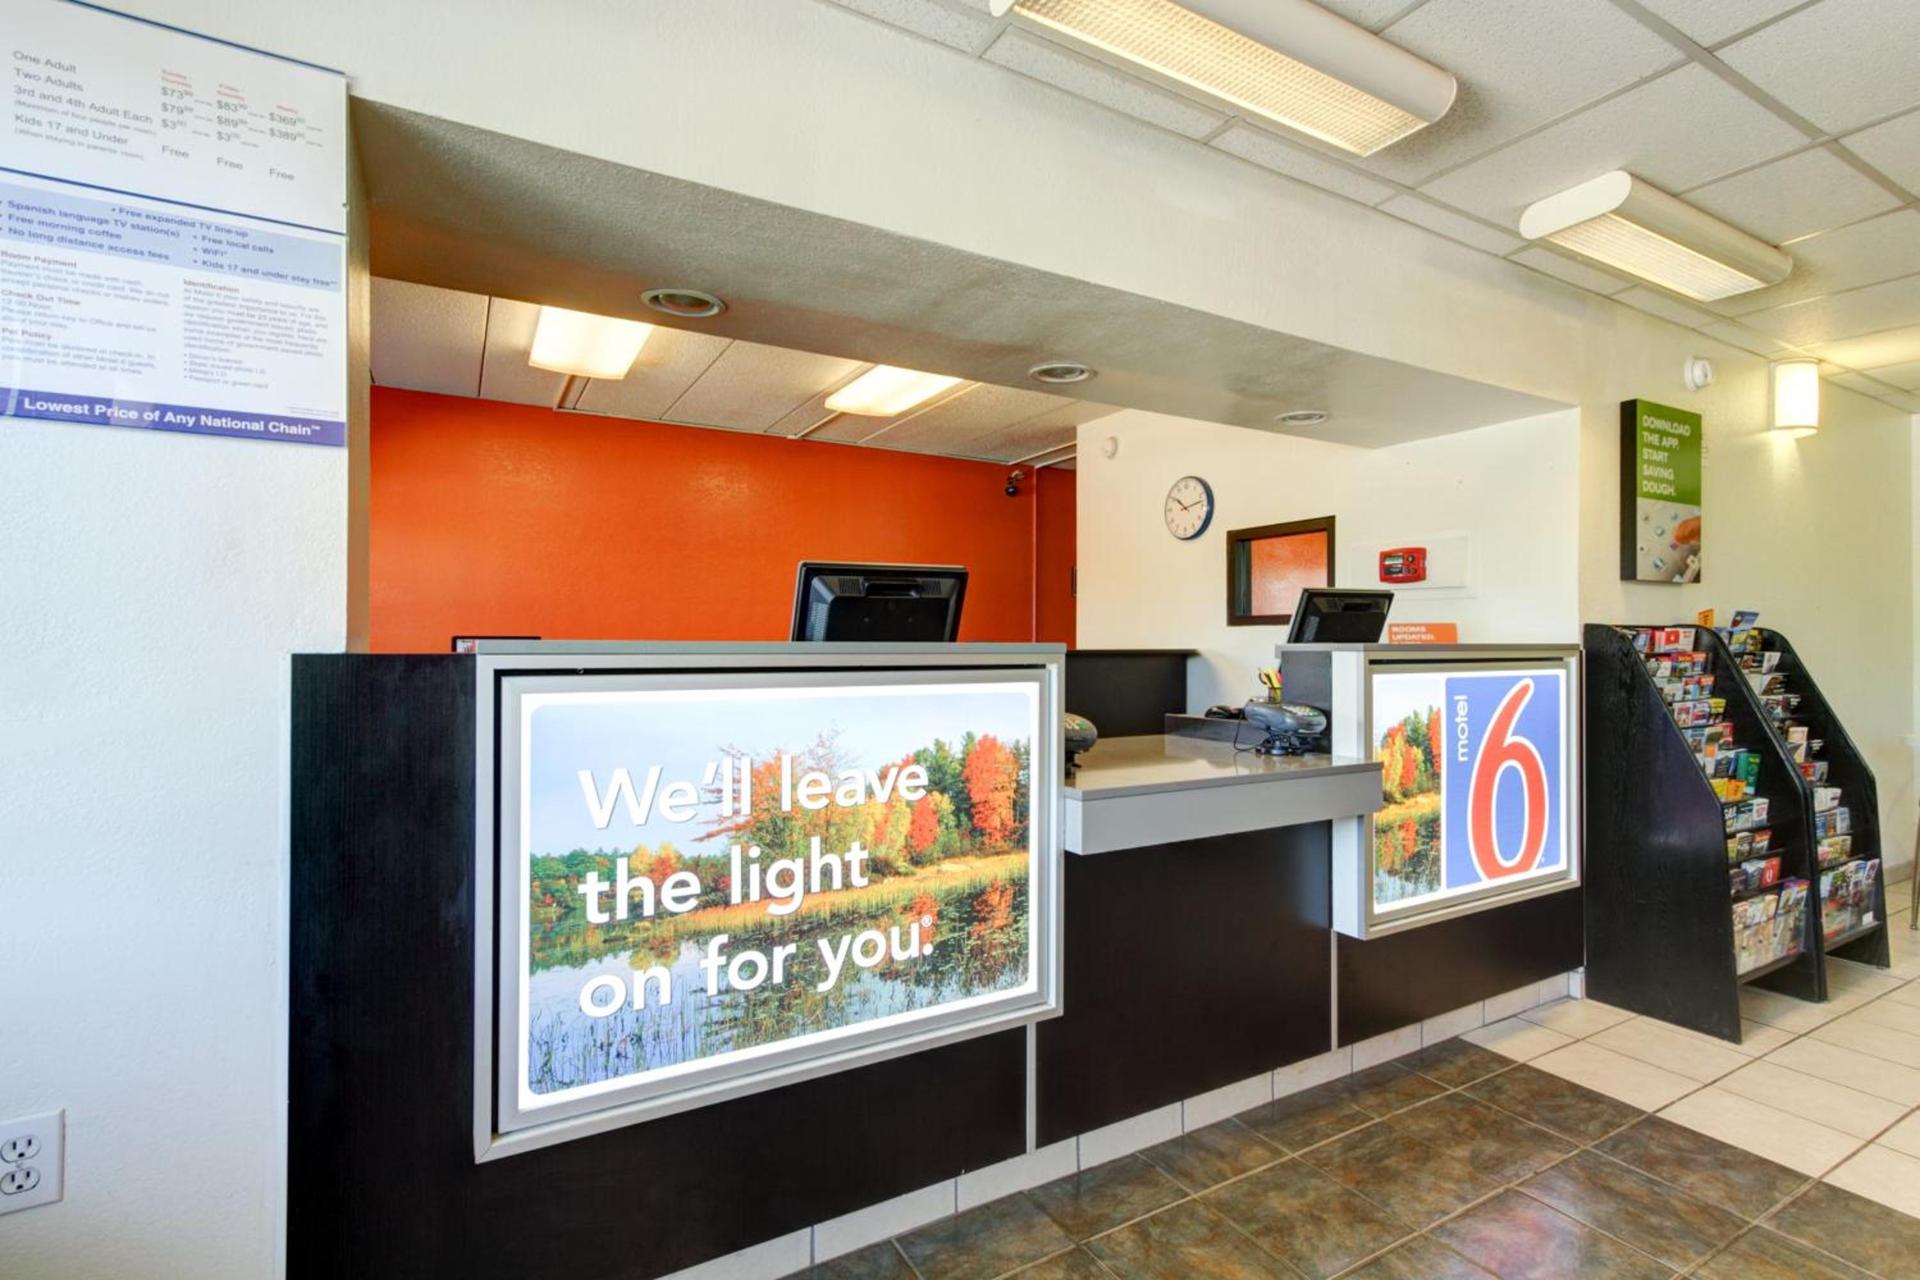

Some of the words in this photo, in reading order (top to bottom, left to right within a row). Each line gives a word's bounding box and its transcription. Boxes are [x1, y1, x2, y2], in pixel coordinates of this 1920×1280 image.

[13, 50, 40, 64] One
[44, 58, 77, 74] Adult
[15, 67, 41, 81] Two
[45, 75, 84, 92] Adults
[39, 90, 62, 104] and
[89, 102, 120, 120] Adult
[123, 109, 153, 125] Each
[15, 113, 43, 128] Kids
[66, 125, 89, 138] and
[92, 130, 128, 146] Under
[161, 145, 189, 159] Free
[216, 157, 243, 170] Free
[269, 168, 295, 181] Free
[8, 200, 56, 216] Spanish
[59, 210, 110, 226] language
[113, 219, 127, 229] TV
[8, 213, 34, 226] Free
[38, 220, 86, 235] morning
[88, 228, 122, 241] coffee
[119, 207, 142, 219] Free
[145, 213, 196, 229] expanded
[200, 221, 211, 231] TV
[8, 227, 25, 237] No
[28, 230, 54, 242] long
[57, 235, 105, 250] distance
[107, 244, 145, 257] access
[148, 251, 170, 261] fees
[201, 234, 223, 246] Free
[226, 239, 249, 250] local
[252, 243, 275, 255] calls
[202, 260, 224, 271] Kids
[241, 267, 259, 276] and
[262, 271, 289, 281] under
[291, 275, 310, 286] stay
[24, 397, 90, 416] Lowest
[95, 405, 138, 421] Price
[143, 409, 160, 422] of
[164, 412, 196, 428] Any
[201, 415, 264, 432] National
[1642, 414, 1692, 437] DOWNLOAD
[1642, 431, 1660, 446] THE
[1642, 448, 1668, 464] START
[1642, 464, 1674, 481] SAVING
[1453, 694, 1469, 762] motel
[577, 757, 752, 830] We'll
[780, 754, 929, 812] leave
[1467, 677, 1550, 883] 6
[577, 856, 702, 925] the
[730, 835, 869, 916] light
[579, 962, 672, 1019] on
[700, 934, 798, 997] for
